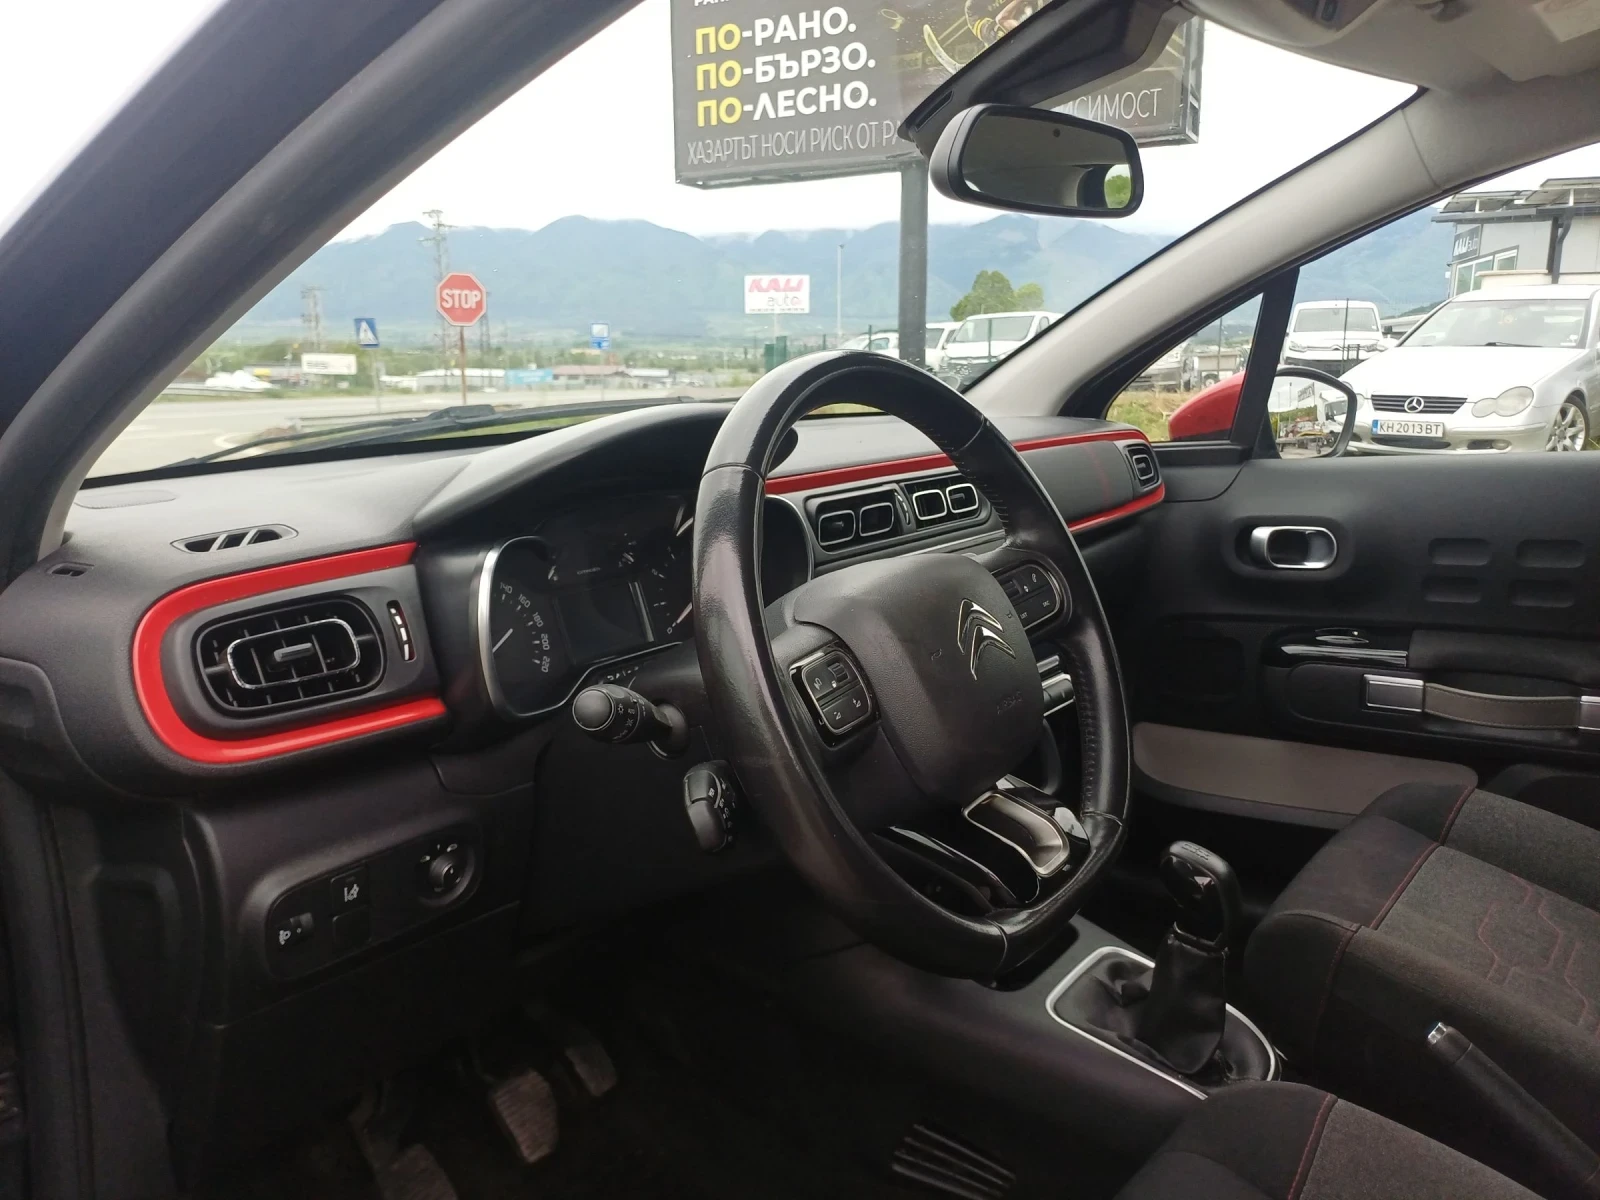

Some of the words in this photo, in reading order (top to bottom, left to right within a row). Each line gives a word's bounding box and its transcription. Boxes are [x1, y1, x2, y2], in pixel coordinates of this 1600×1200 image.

[695, 6, 857, 55] ПО-РАНО.
[696, 42, 876, 91] ПО-БЪРЗО.
[697, 80, 877, 127] ПО-ЛЕСНО.
[687, 134, 759, 165] ХАЗАРТЪТ
[761, 130, 806, 157] НОСИ
[810, 125, 854, 154] РИСК
[856, 121, 879, 149] ОТ
[441, 288, 482, 309] STOP
[540, 633, 550, 651] 200
[541, 655, 550, 673] 220
